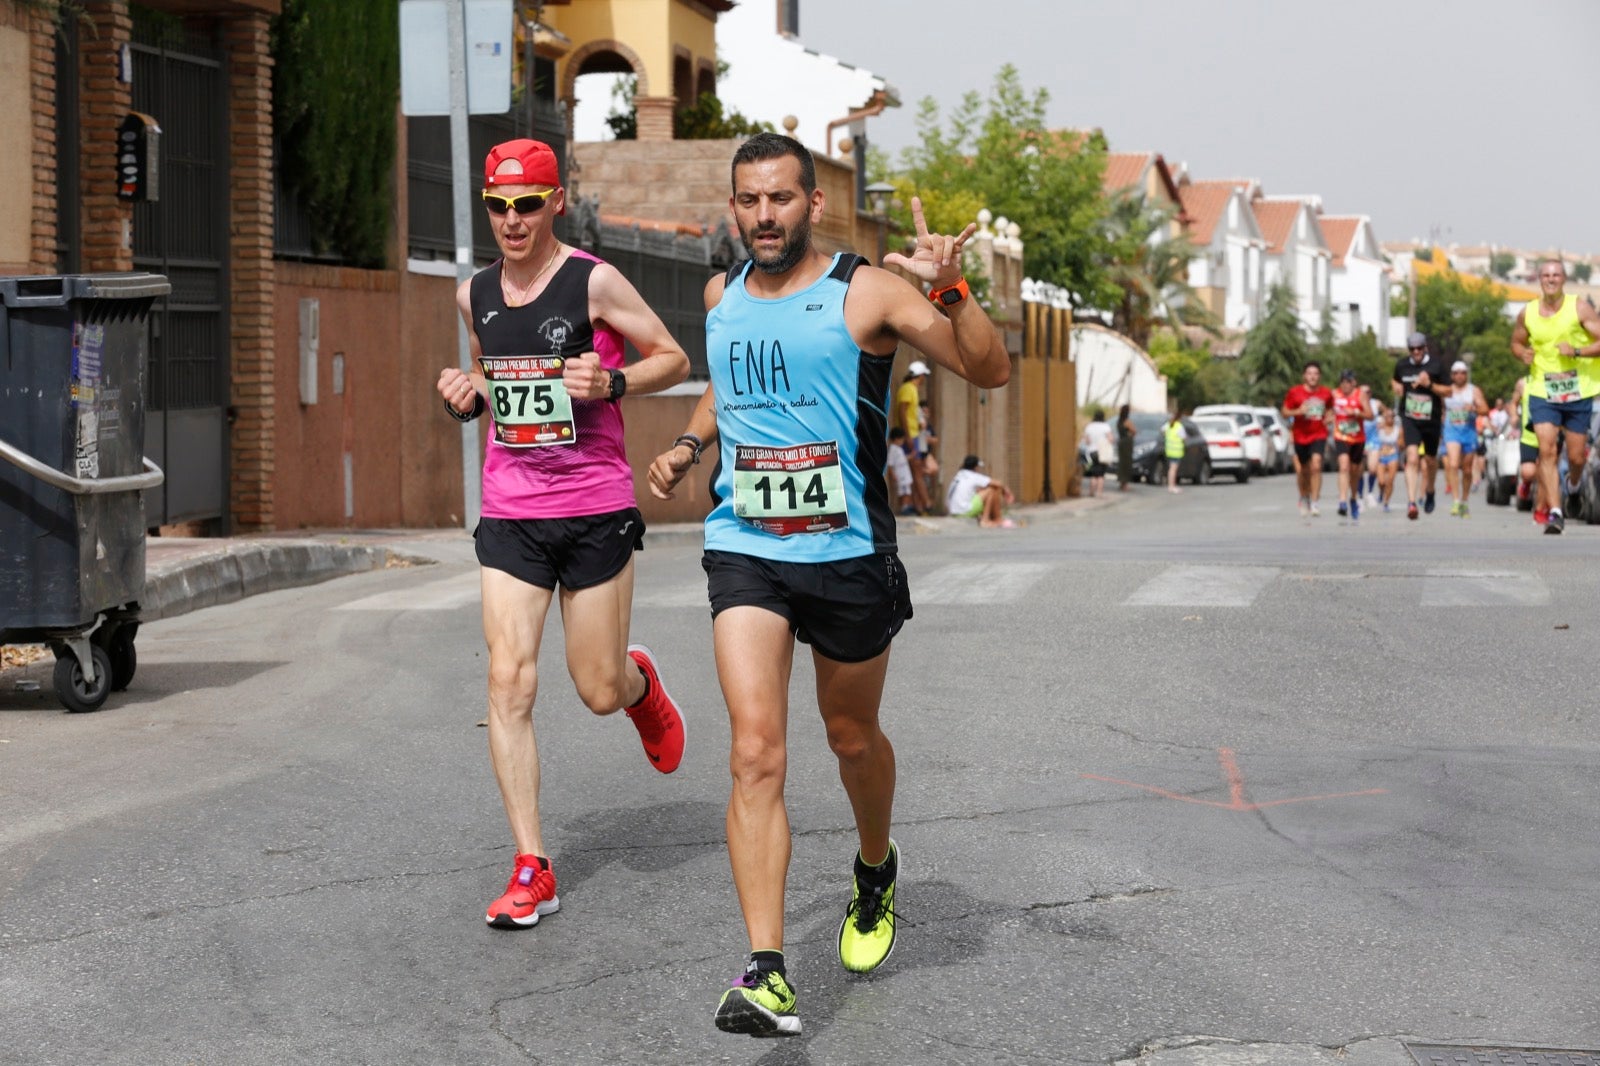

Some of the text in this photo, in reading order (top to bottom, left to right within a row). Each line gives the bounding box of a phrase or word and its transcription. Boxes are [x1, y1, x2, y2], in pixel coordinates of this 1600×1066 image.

[493, 359, 509, 371] GRAN
[509, 359, 530, 371] PREMIO
[530, 359, 538, 370] DE
[729, 339, 791, 396] ENA
[494, 385, 555, 417] 875
[779, 401, 788, 413] y
[790, 393, 819, 408] salud
[756, 449, 774, 460] GRAN
[774, 448, 799, 461] PREMIO
[799, 447, 808, 459] DE
[809, 444, 832, 457] FONDO
[754, 473, 829, 510] 114
